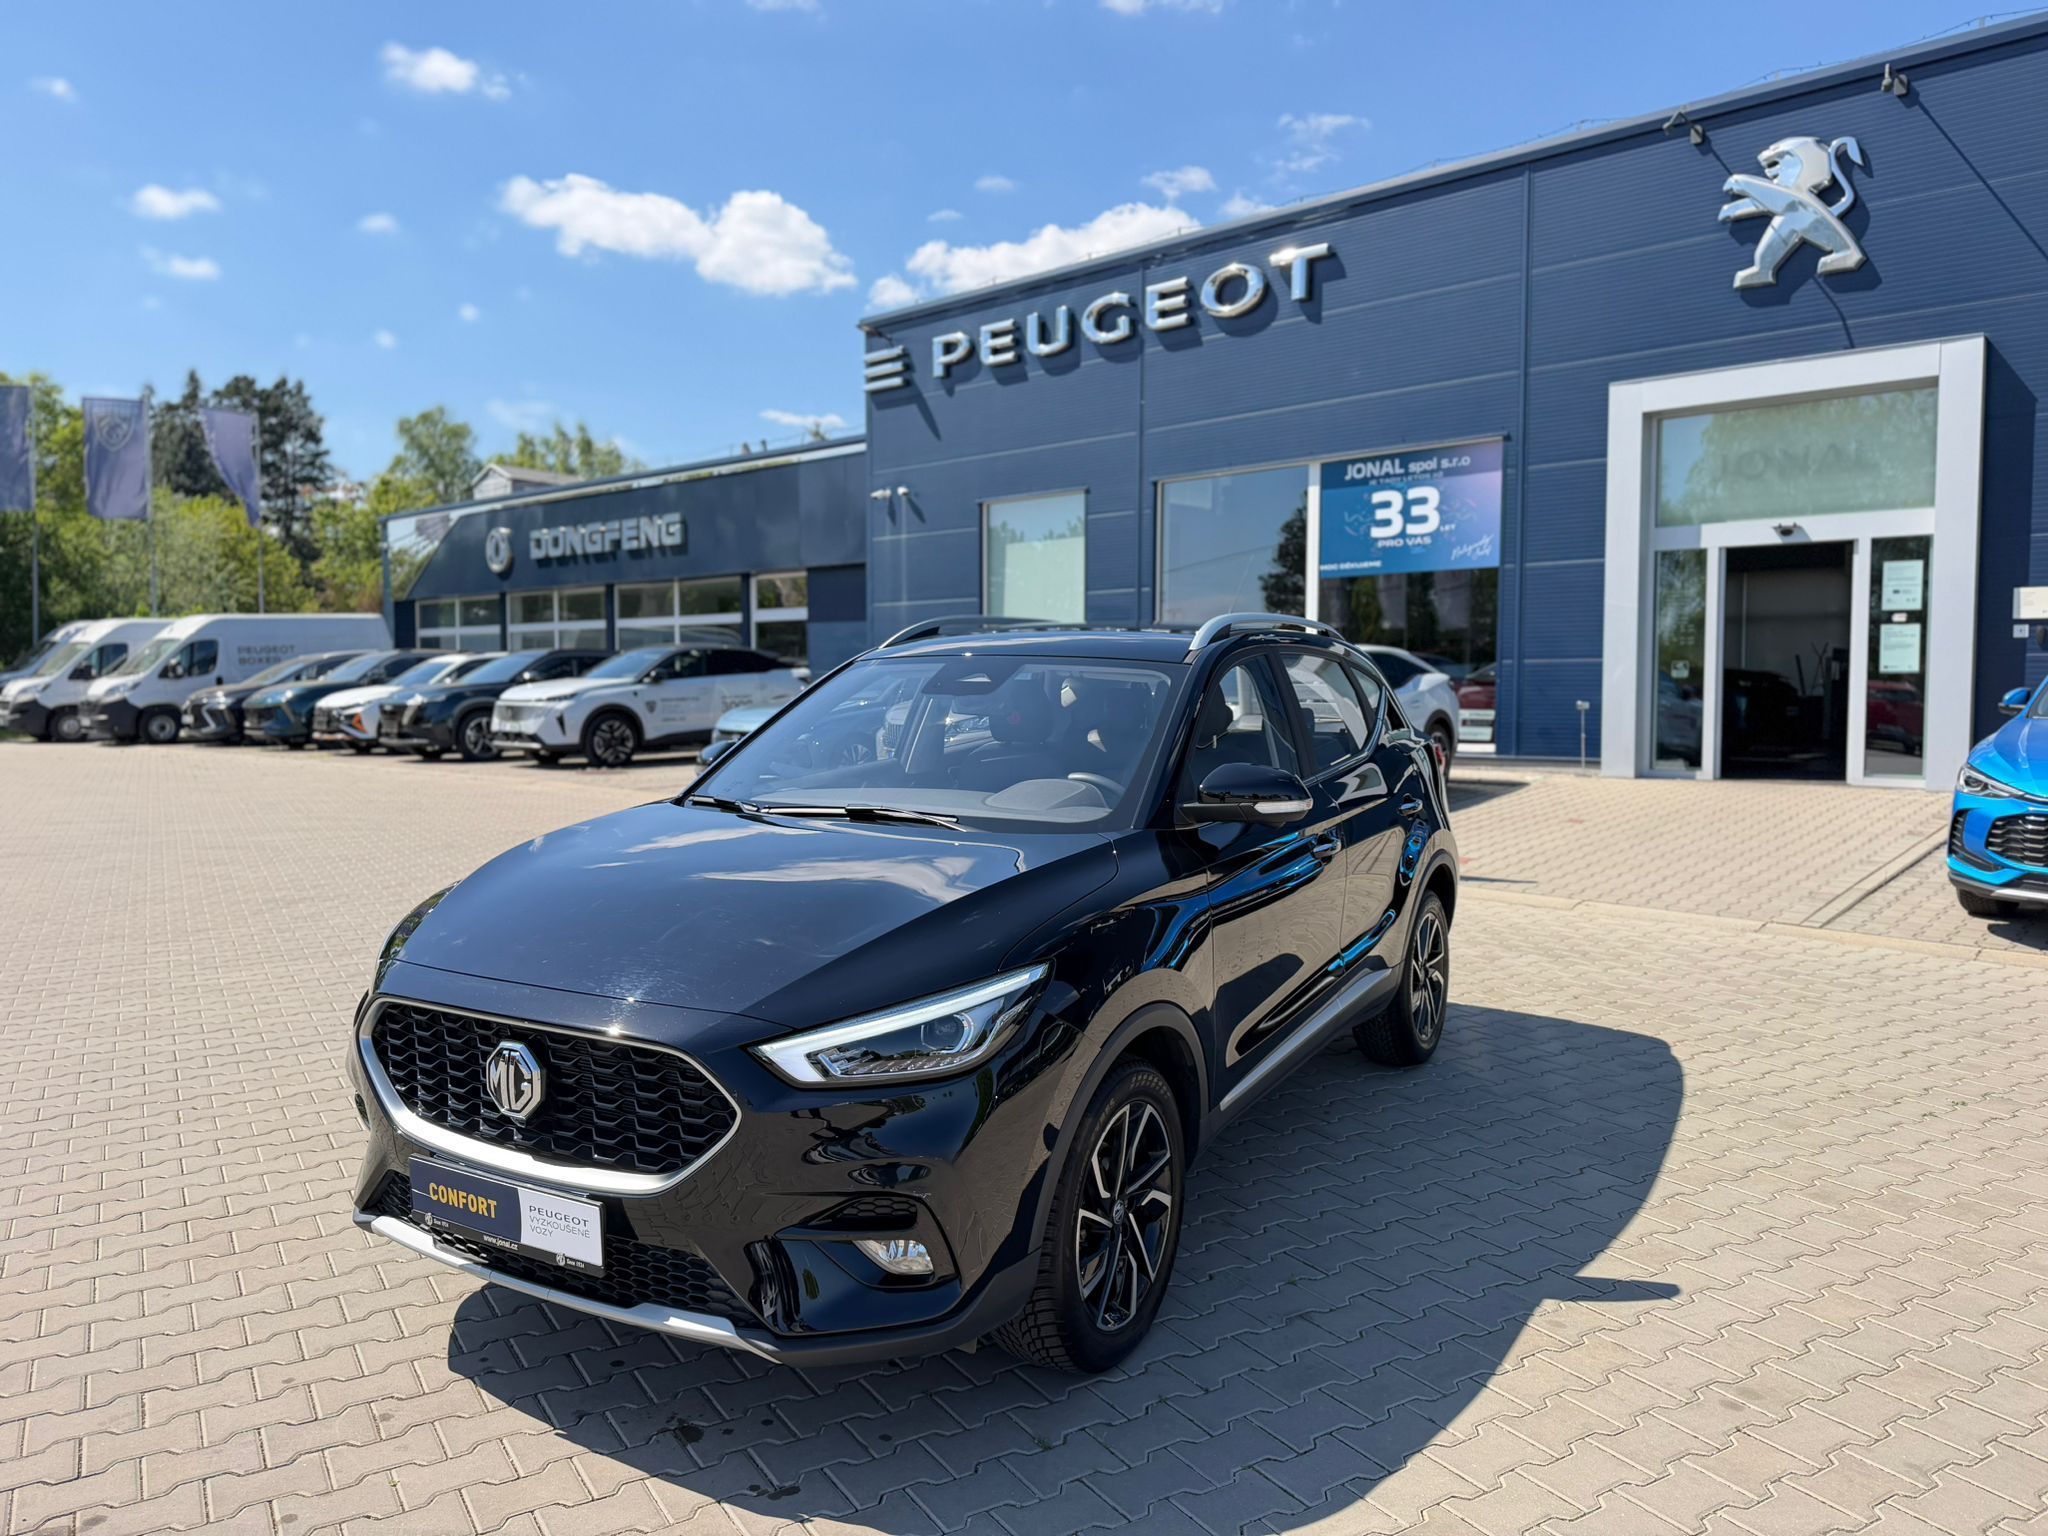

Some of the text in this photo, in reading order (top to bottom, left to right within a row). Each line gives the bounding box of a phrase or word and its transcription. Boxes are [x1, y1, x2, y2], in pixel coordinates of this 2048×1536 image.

[931, 242, 1330, 379] PEUGEOT
[1344, 458, 1406, 480] JONAL
[1408, 457, 1437, 474] spol
[1370, 486, 1441, 539] 33
[529, 512, 682, 560] DONGFENG
[1377, 538, 1404, 548] PRO
[488, 1048, 533, 1112] MG
[429, 1182, 497, 1219] CONFORT
[529, 1205, 589, 1228] PEUGEOT
[529, 1224, 554, 1237] VOZY
[483, 1234, 519, 1251] www.jonal.cz
